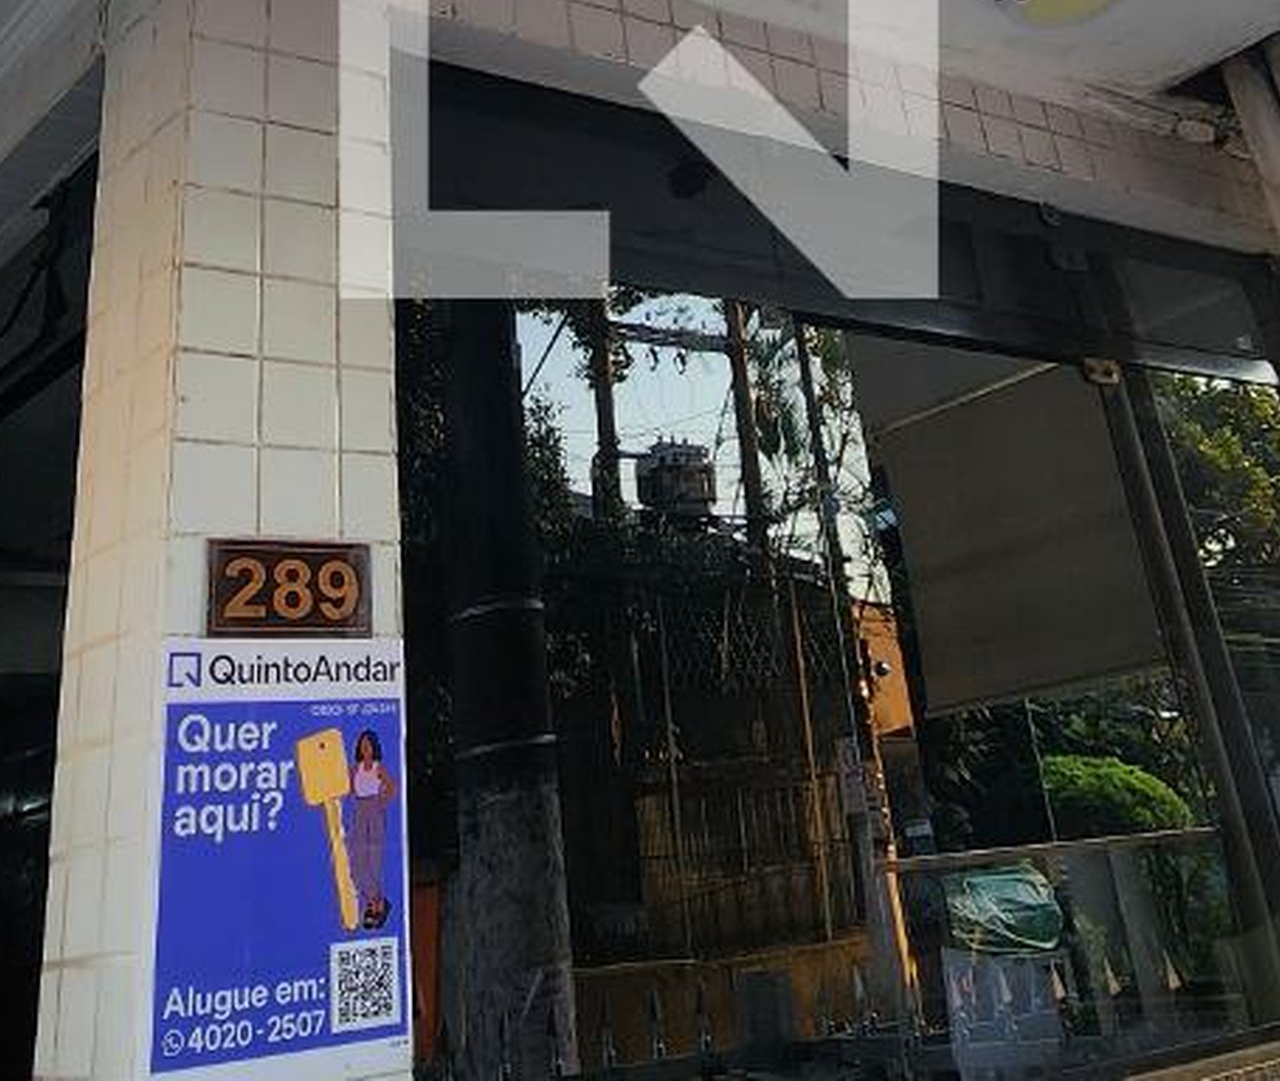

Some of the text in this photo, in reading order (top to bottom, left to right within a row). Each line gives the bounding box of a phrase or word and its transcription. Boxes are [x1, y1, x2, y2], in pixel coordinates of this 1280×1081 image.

[223, 559, 360, 619] 289
[209, 655, 401, 686] QuintoAndar
[178, 715, 276, 753] Quer
[177, 761, 294, 792] morar
[174, 792, 283, 843] aqui?
[164, 978, 326, 1019] Alugue em:
